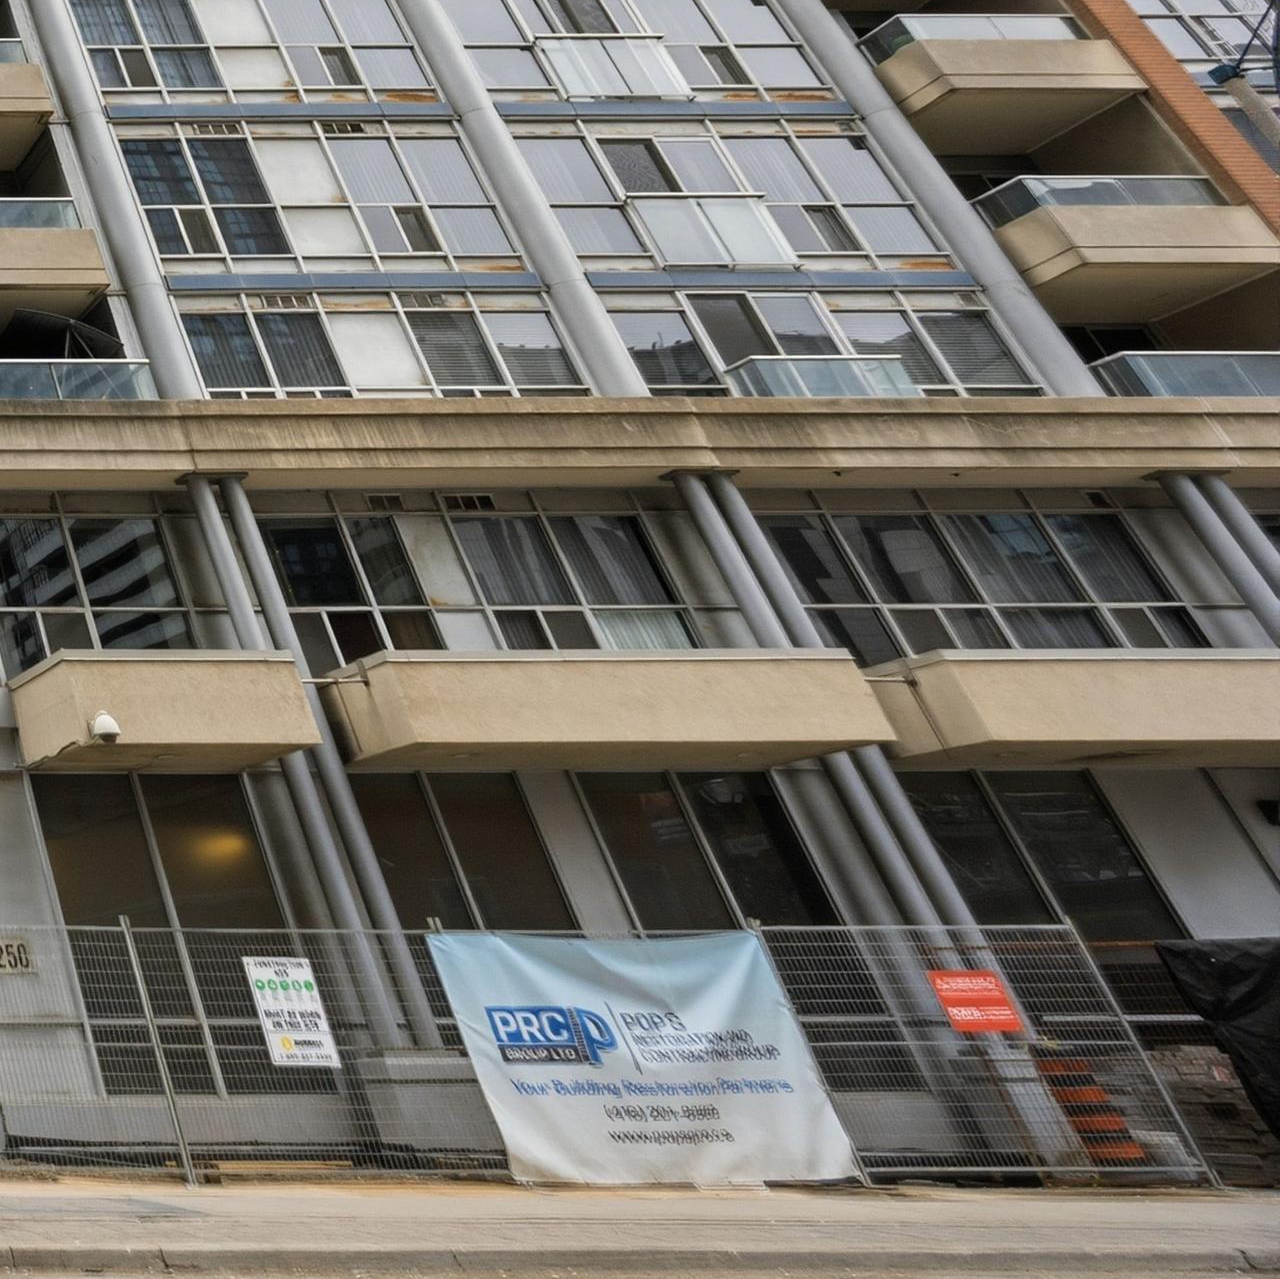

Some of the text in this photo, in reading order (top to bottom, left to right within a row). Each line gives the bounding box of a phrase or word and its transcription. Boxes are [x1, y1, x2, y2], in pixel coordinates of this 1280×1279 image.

[491, 1010, 569, 1043] PRC
[619, 1012, 687, 1032] POPS
[551, 1047, 576, 1060] LTD
